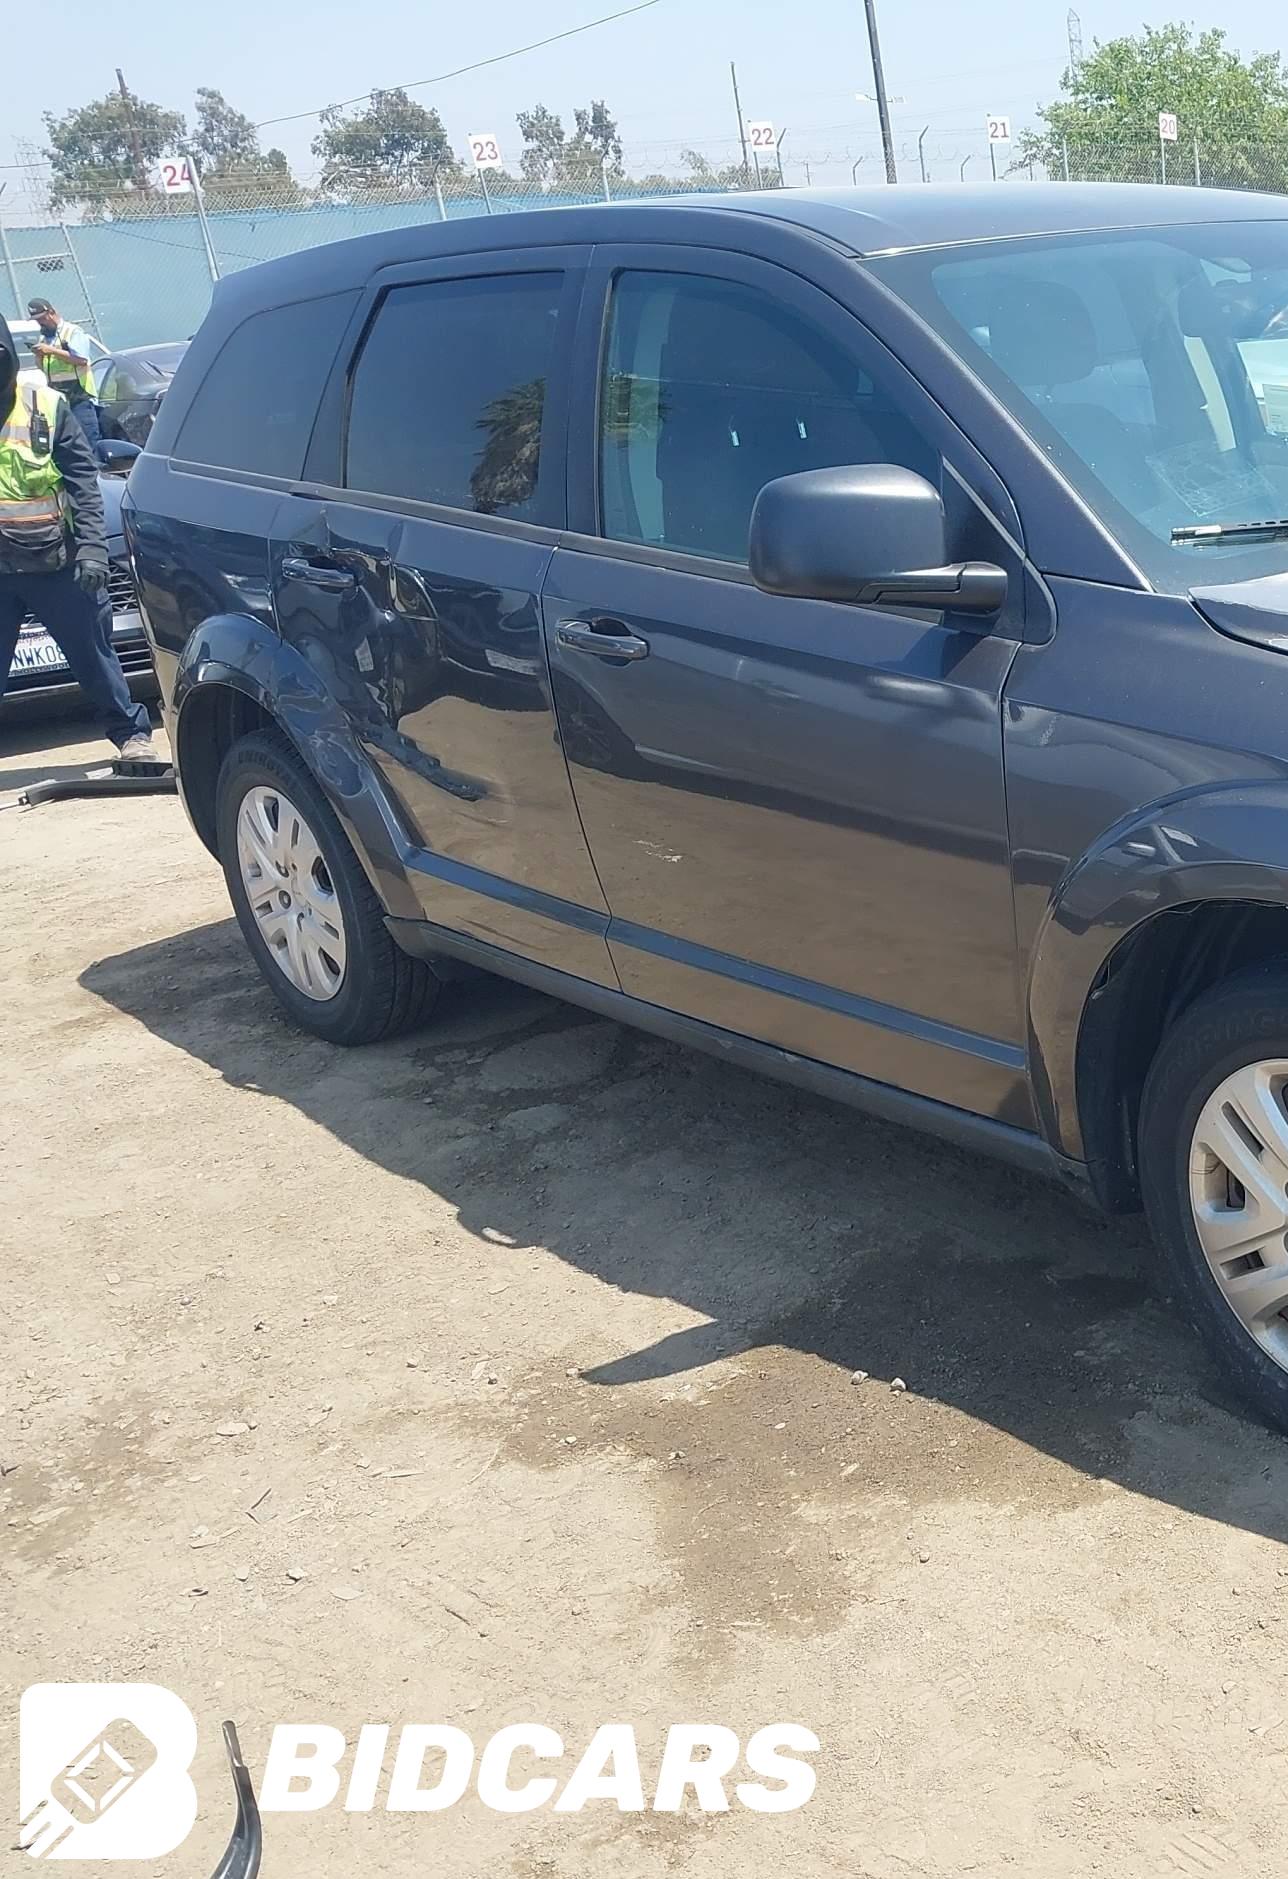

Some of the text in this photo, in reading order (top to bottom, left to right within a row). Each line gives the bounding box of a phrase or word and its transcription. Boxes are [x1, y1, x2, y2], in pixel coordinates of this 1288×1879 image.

[989, 122, 1009, 138] 21
[1161, 118, 1175, 134] 20
[751, 127, 775, 146] 22
[473, 141, 498, 161] 23
[163, 163, 193, 187] 24
